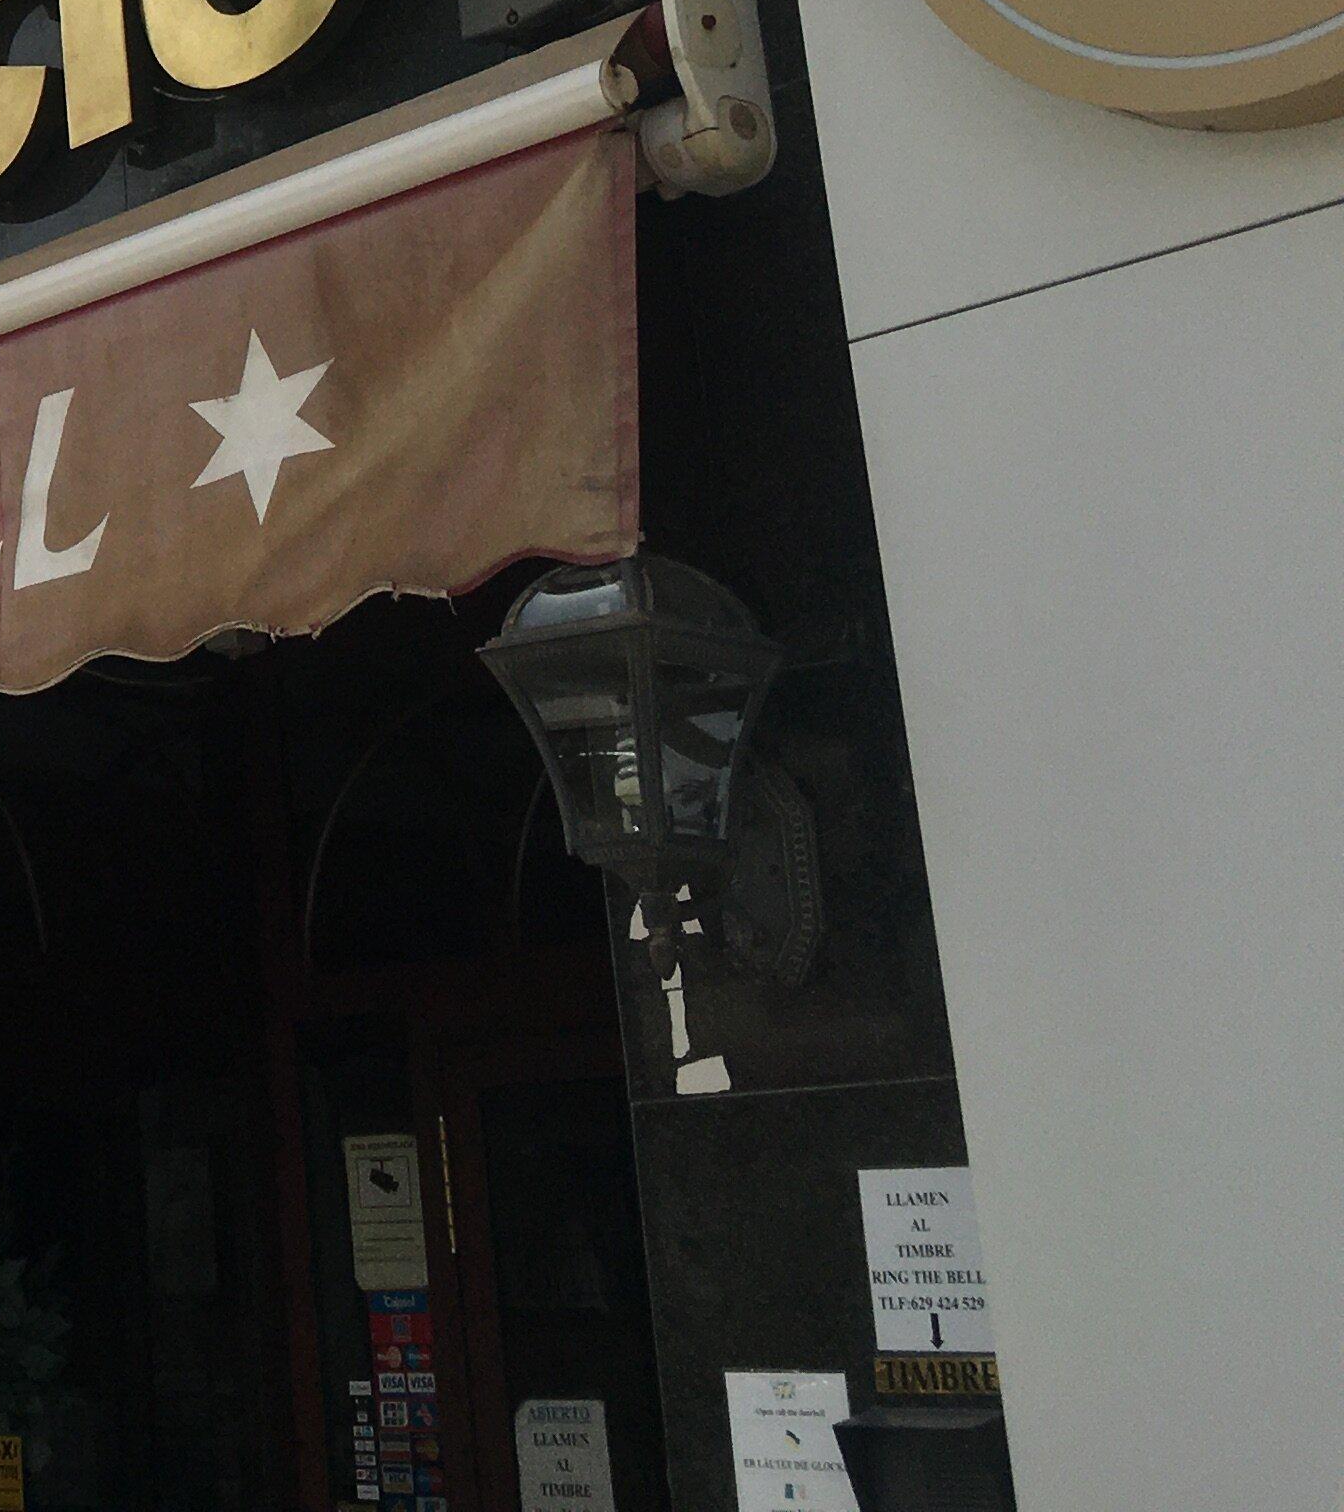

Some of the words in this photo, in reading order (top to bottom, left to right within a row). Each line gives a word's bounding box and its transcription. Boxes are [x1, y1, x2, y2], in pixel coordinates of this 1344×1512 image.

[885, 1191, 950, 1207] LLAMEN
[910, 1217, 931, 1233] AL
[896, 1243, 955, 1259] TIMBRE
[872, 1270, 908, 1285] RING
[911, 1270, 944, 1285] THE
[947, 1270, 987, 1285] BELL
[938, 1296, 959, 1311] 424
[962, 1296, 986, 1311] 529
[382, 1375, 405, 1389] VISA
[409, 1375, 433, 1389] VISA
[881, 1359, 998, 1391] TIMBRE
[533, 1432, 591, 1448] LLAMEN
[539, 1483, 592, 1498] TIMBRE
